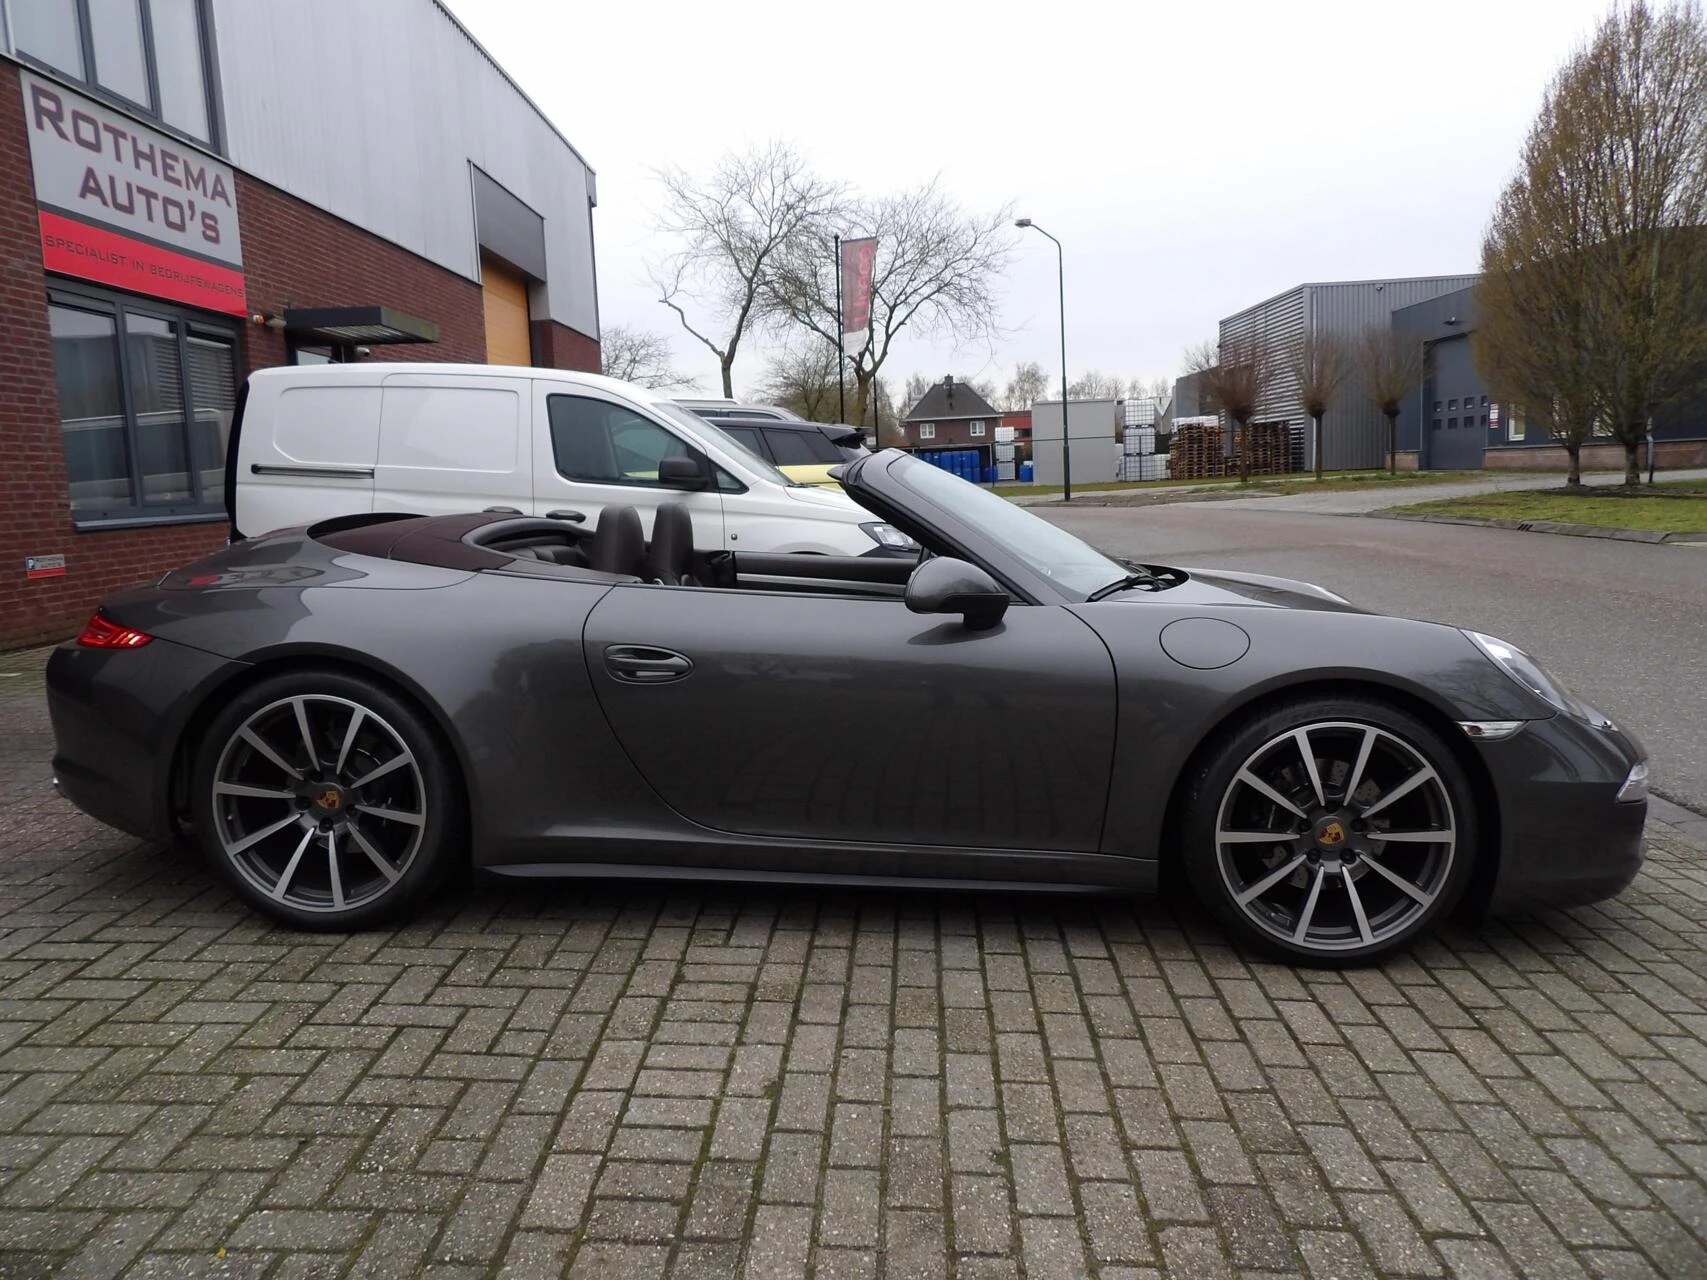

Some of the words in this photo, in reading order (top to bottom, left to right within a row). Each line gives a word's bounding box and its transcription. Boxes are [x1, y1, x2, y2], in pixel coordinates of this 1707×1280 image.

[30, 82, 232, 208] ROTHEMA
[78, 165, 221, 245] AUTO'S
[45, 234, 127, 265] SPECIALIST
[132, 260, 144, 272] IN
